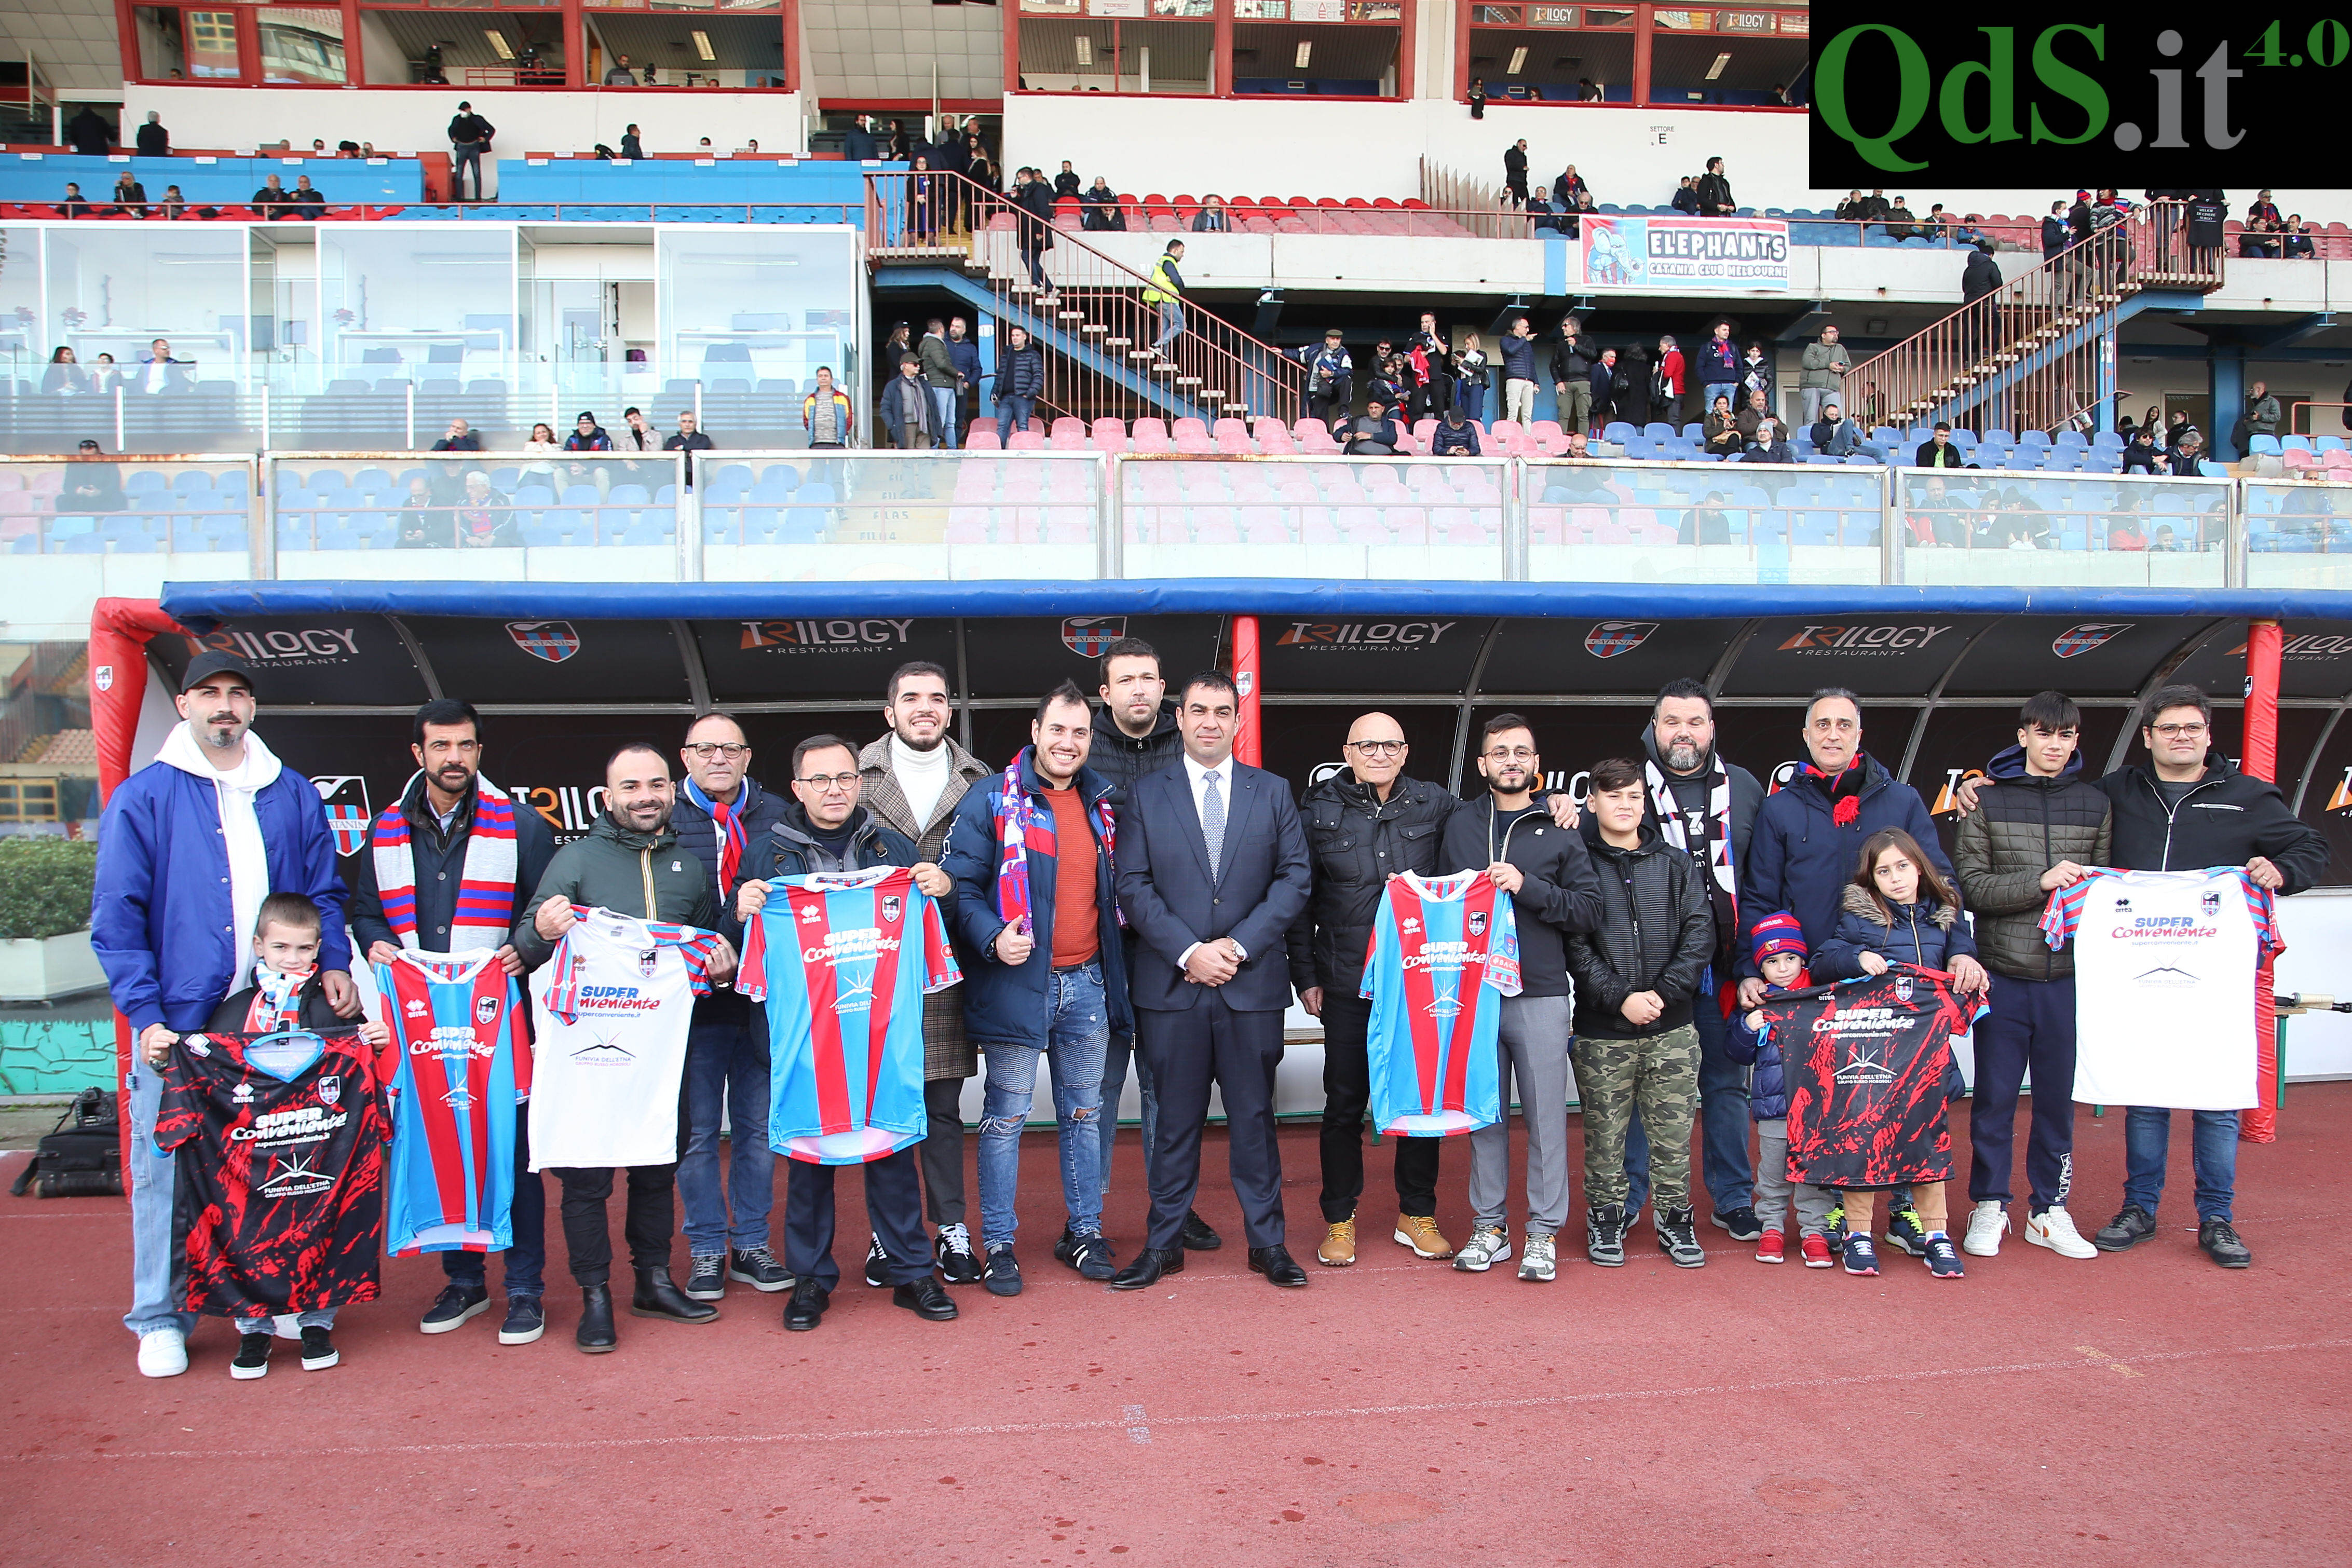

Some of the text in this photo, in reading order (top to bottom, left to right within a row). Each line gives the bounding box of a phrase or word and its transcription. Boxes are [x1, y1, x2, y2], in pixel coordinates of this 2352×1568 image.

[1307, 2, 1338, 10] SMART
[1298, 10, 1338, 19] PROJECT
[1535, 7, 1572, 21] TRILOGY
[1728, 13, 1764, 28] TRILOGY
[1658, 133, 1667, 144] E
[1648, 230, 1787, 262] ELEPHANTS
[1649, 263, 1787, 278] CATANIA CLUB MELBOURNE
[741, 619, 914, 645] TRILOGY
[1291, 622, 1457, 644] TRILOGY
[1793, 626, 1953, 648] TRILOGY
[244, 658, 337, 669] ESTAURANT
[329, 821, 367, 829] ATANIA
[2135, 917, 2194, 928] SUPER
[823, 927, 882, 946] SUPER
[2111, 925, 2218, 939] Conveniente
[803, 935, 901, 963] Conveniente
[1420, 941, 1469, 955] SUPER
[581, 986, 639, 999] SUPER
[577, 997, 661, 1010] nveniente
[1834, 1008, 1894, 1021] SUPER
[1812, 1015, 1916, 1032] Conveniente
[430, 1026, 477, 1040] SUPER
[255, 1107, 324, 1129] SUPER
[230, 1112, 348, 1141] Conveniente
[254, 1131, 331, 1149] superconveniente.it
[264, 1179, 330, 1194] FUNIVIA DELL'ETNA
